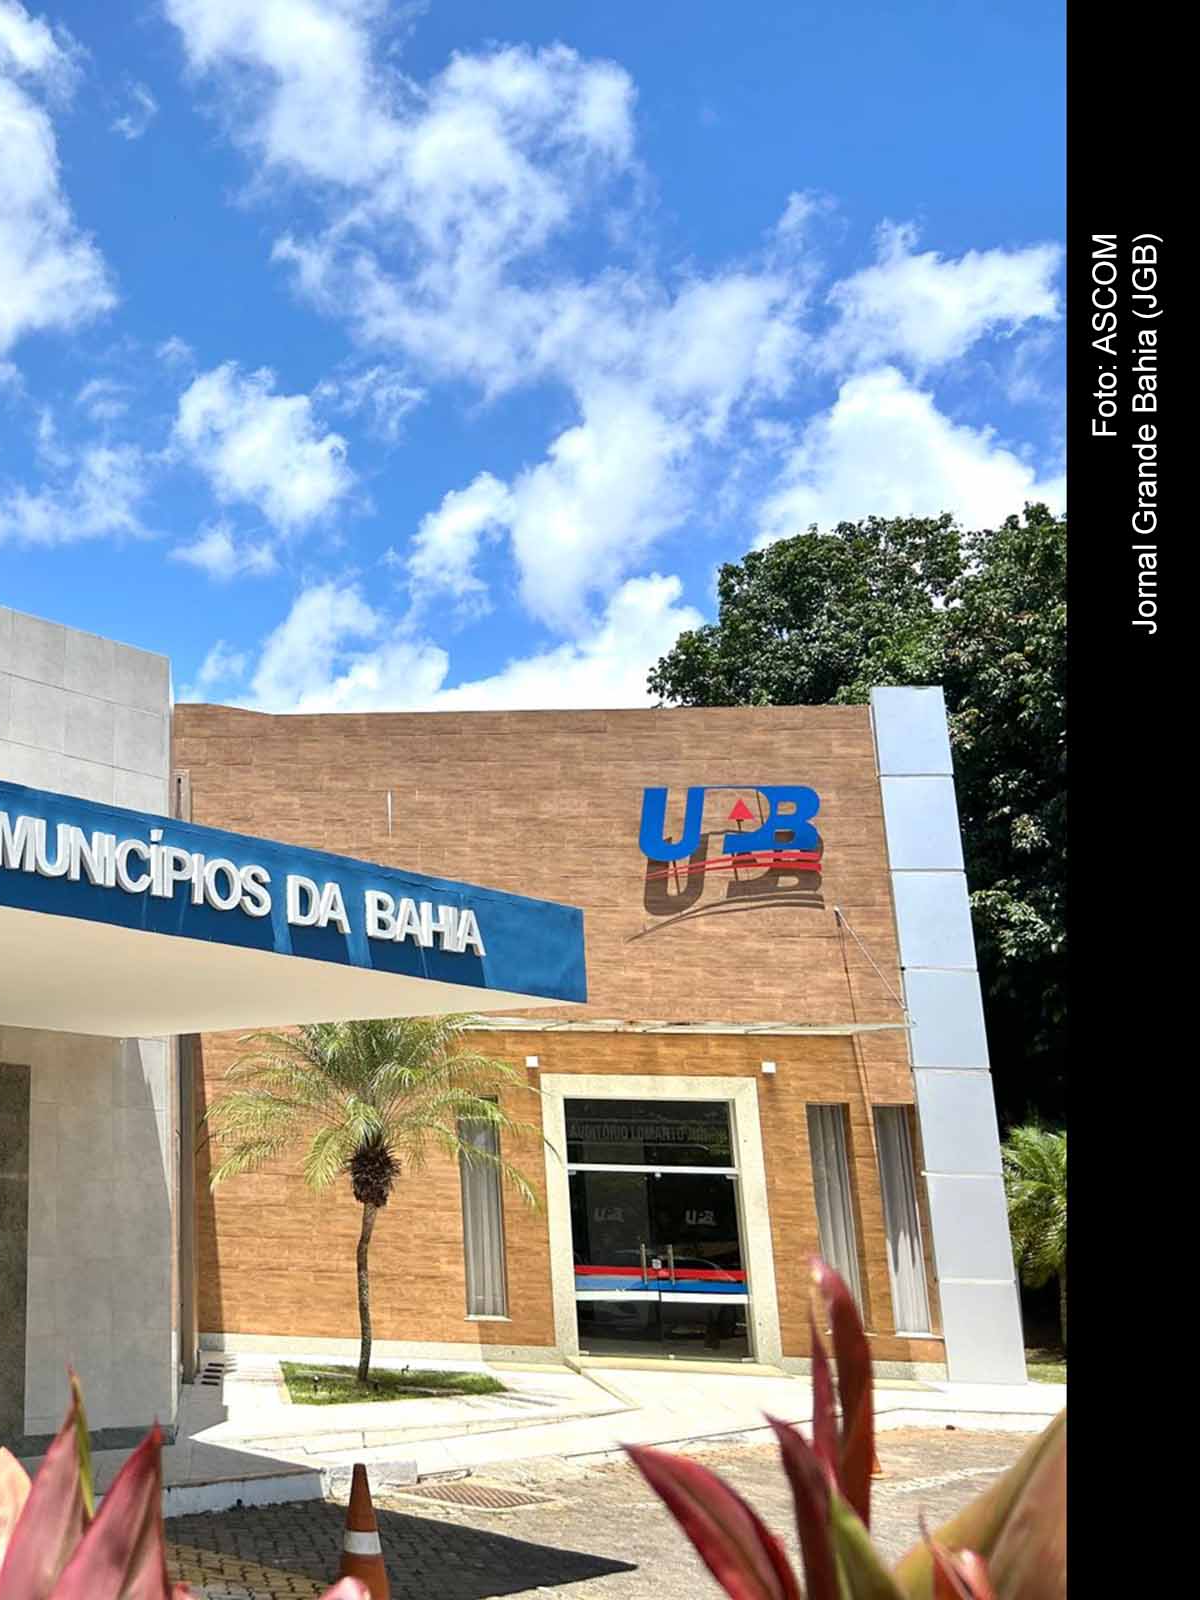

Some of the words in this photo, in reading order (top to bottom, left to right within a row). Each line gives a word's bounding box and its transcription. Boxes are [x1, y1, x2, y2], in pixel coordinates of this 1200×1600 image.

[639, 785, 821, 861] UPB
[286, 874, 351, 934] DA
[364, 889, 487, 956] BAHIA
